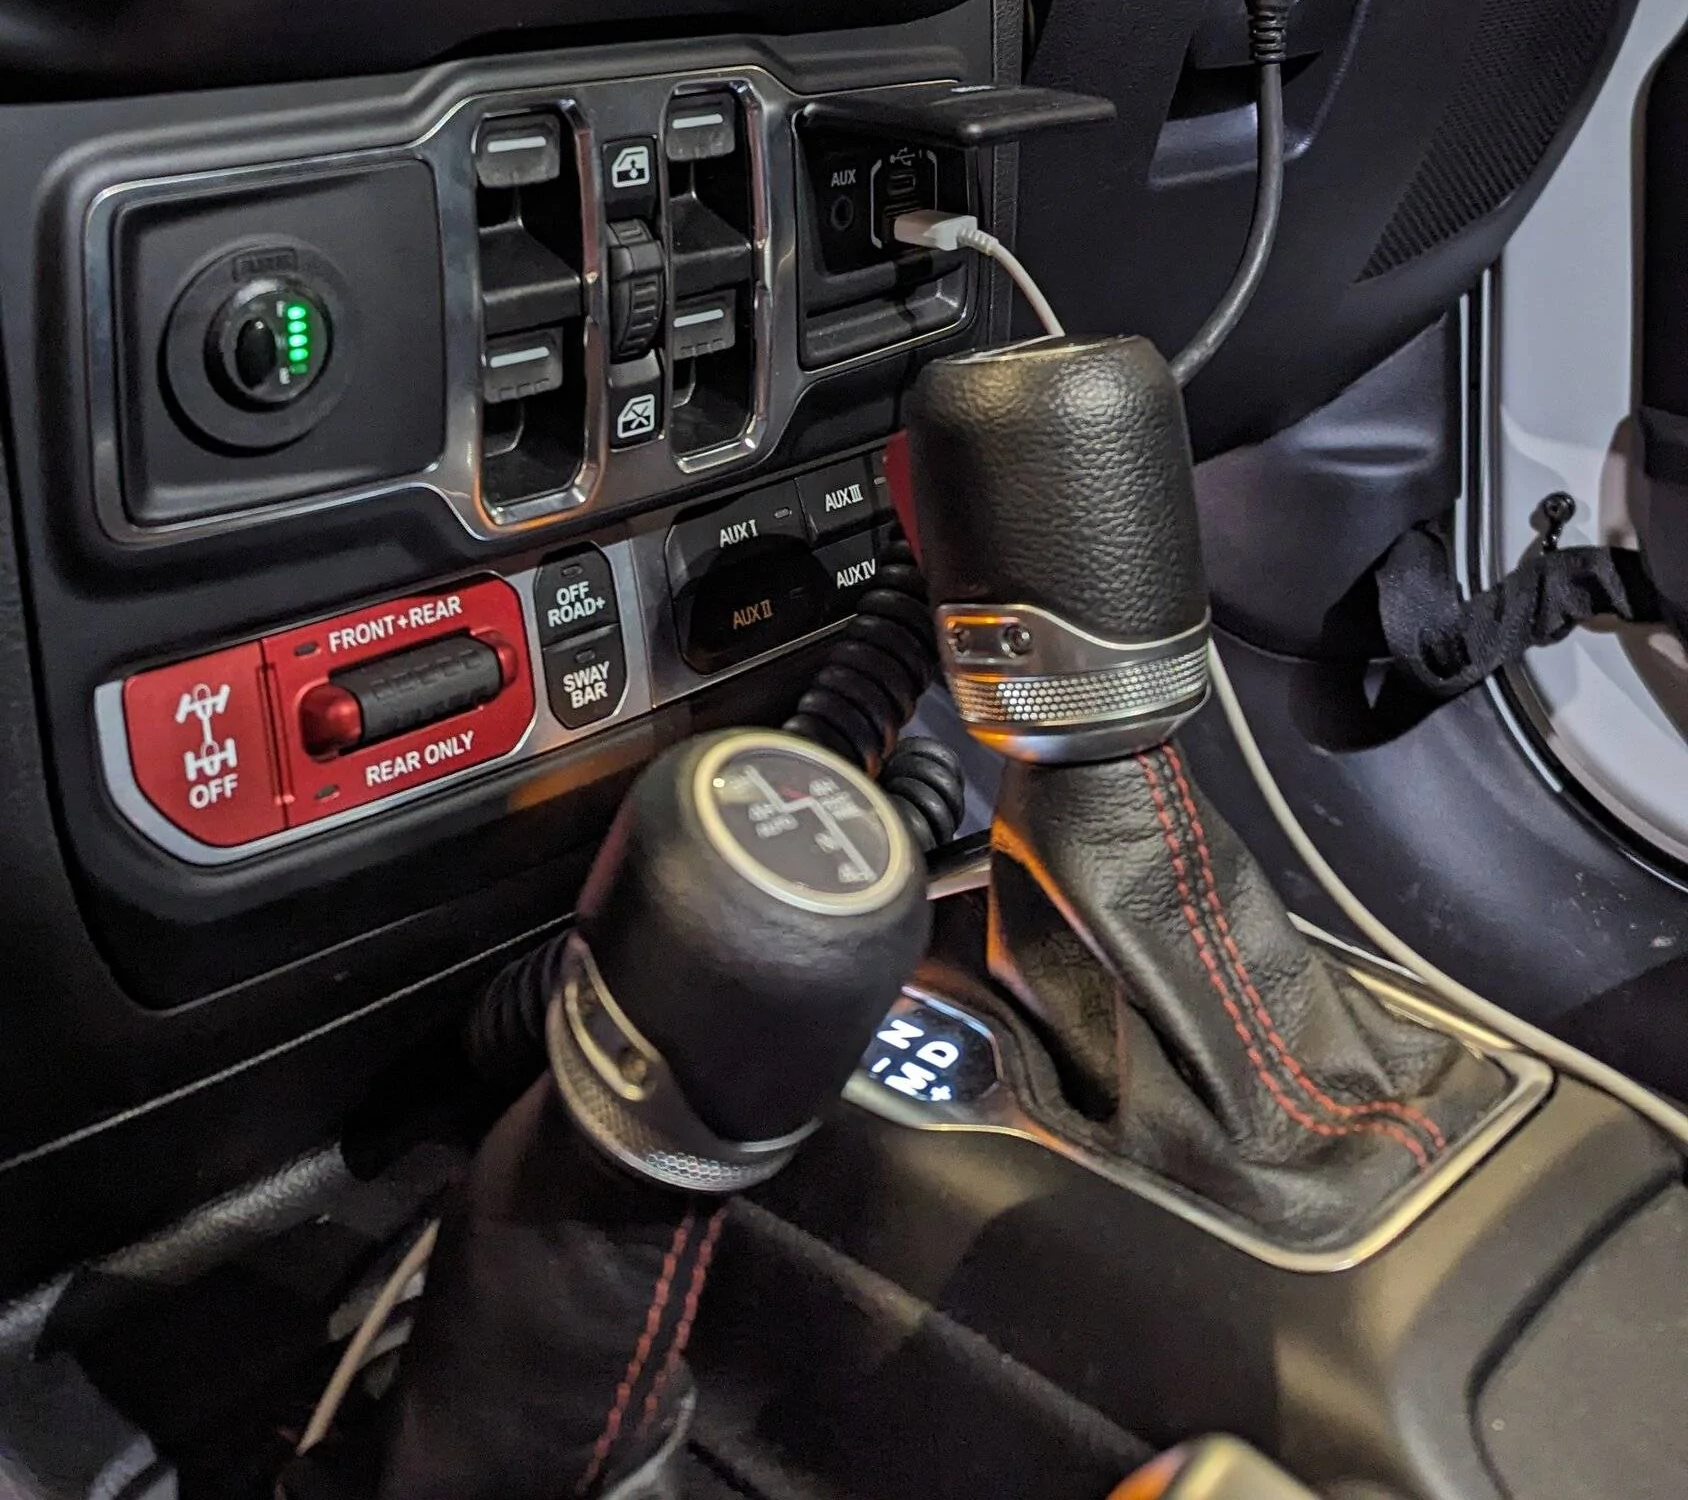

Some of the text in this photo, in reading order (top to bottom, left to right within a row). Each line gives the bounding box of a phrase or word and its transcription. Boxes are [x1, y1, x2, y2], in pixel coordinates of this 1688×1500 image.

[830, 168, 857, 187] AUX
[719, 522, 750, 548] AUX
[556, 581, 590, 606] OFF
[328, 595, 463, 654] FRONT+REAR
[547, 596, 606, 628] ROAD+
[733, 603, 761, 630] AUX
[562, 661, 610, 693] SWAY
[571, 681, 608, 709] BAR
[364, 730, 475, 788] REAR ONLY
[188, 773, 239, 809] OFF
[876, 1019, 925, 1050] N
[915, 1040, 959, 1069] D
[884, 1061, 937, 1097] M
